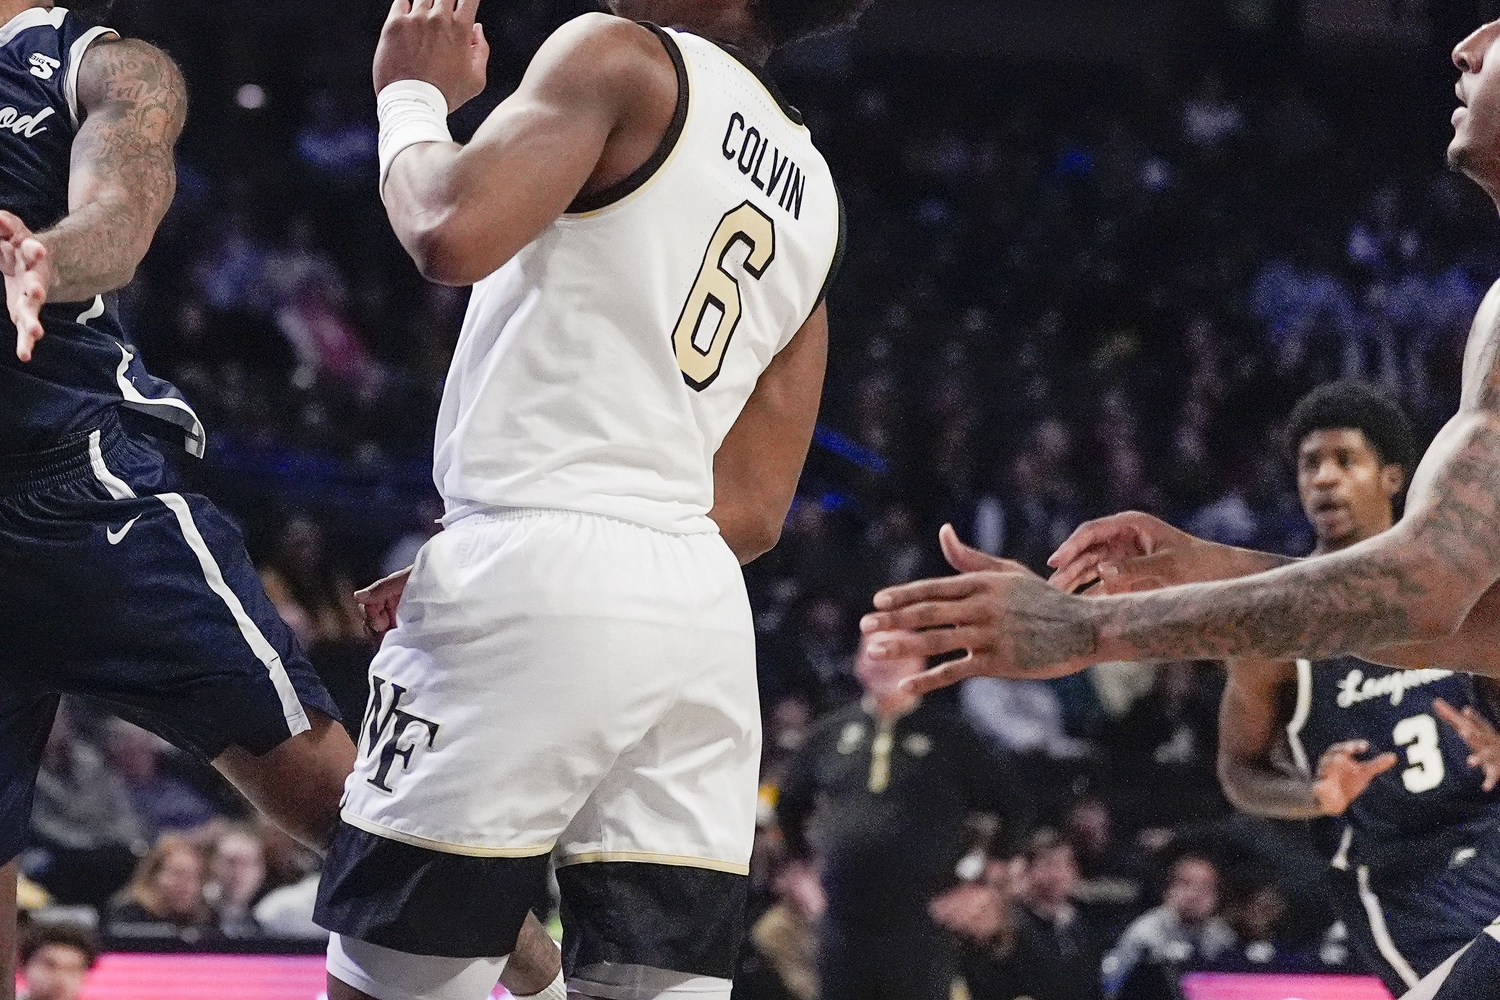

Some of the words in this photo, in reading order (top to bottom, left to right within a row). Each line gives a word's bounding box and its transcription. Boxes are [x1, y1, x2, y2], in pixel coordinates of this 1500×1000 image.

[721, 111, 806, 221] COLVIN
[670, 198, 776, 393] 6
[1392, 712, 1445, 794] 3
